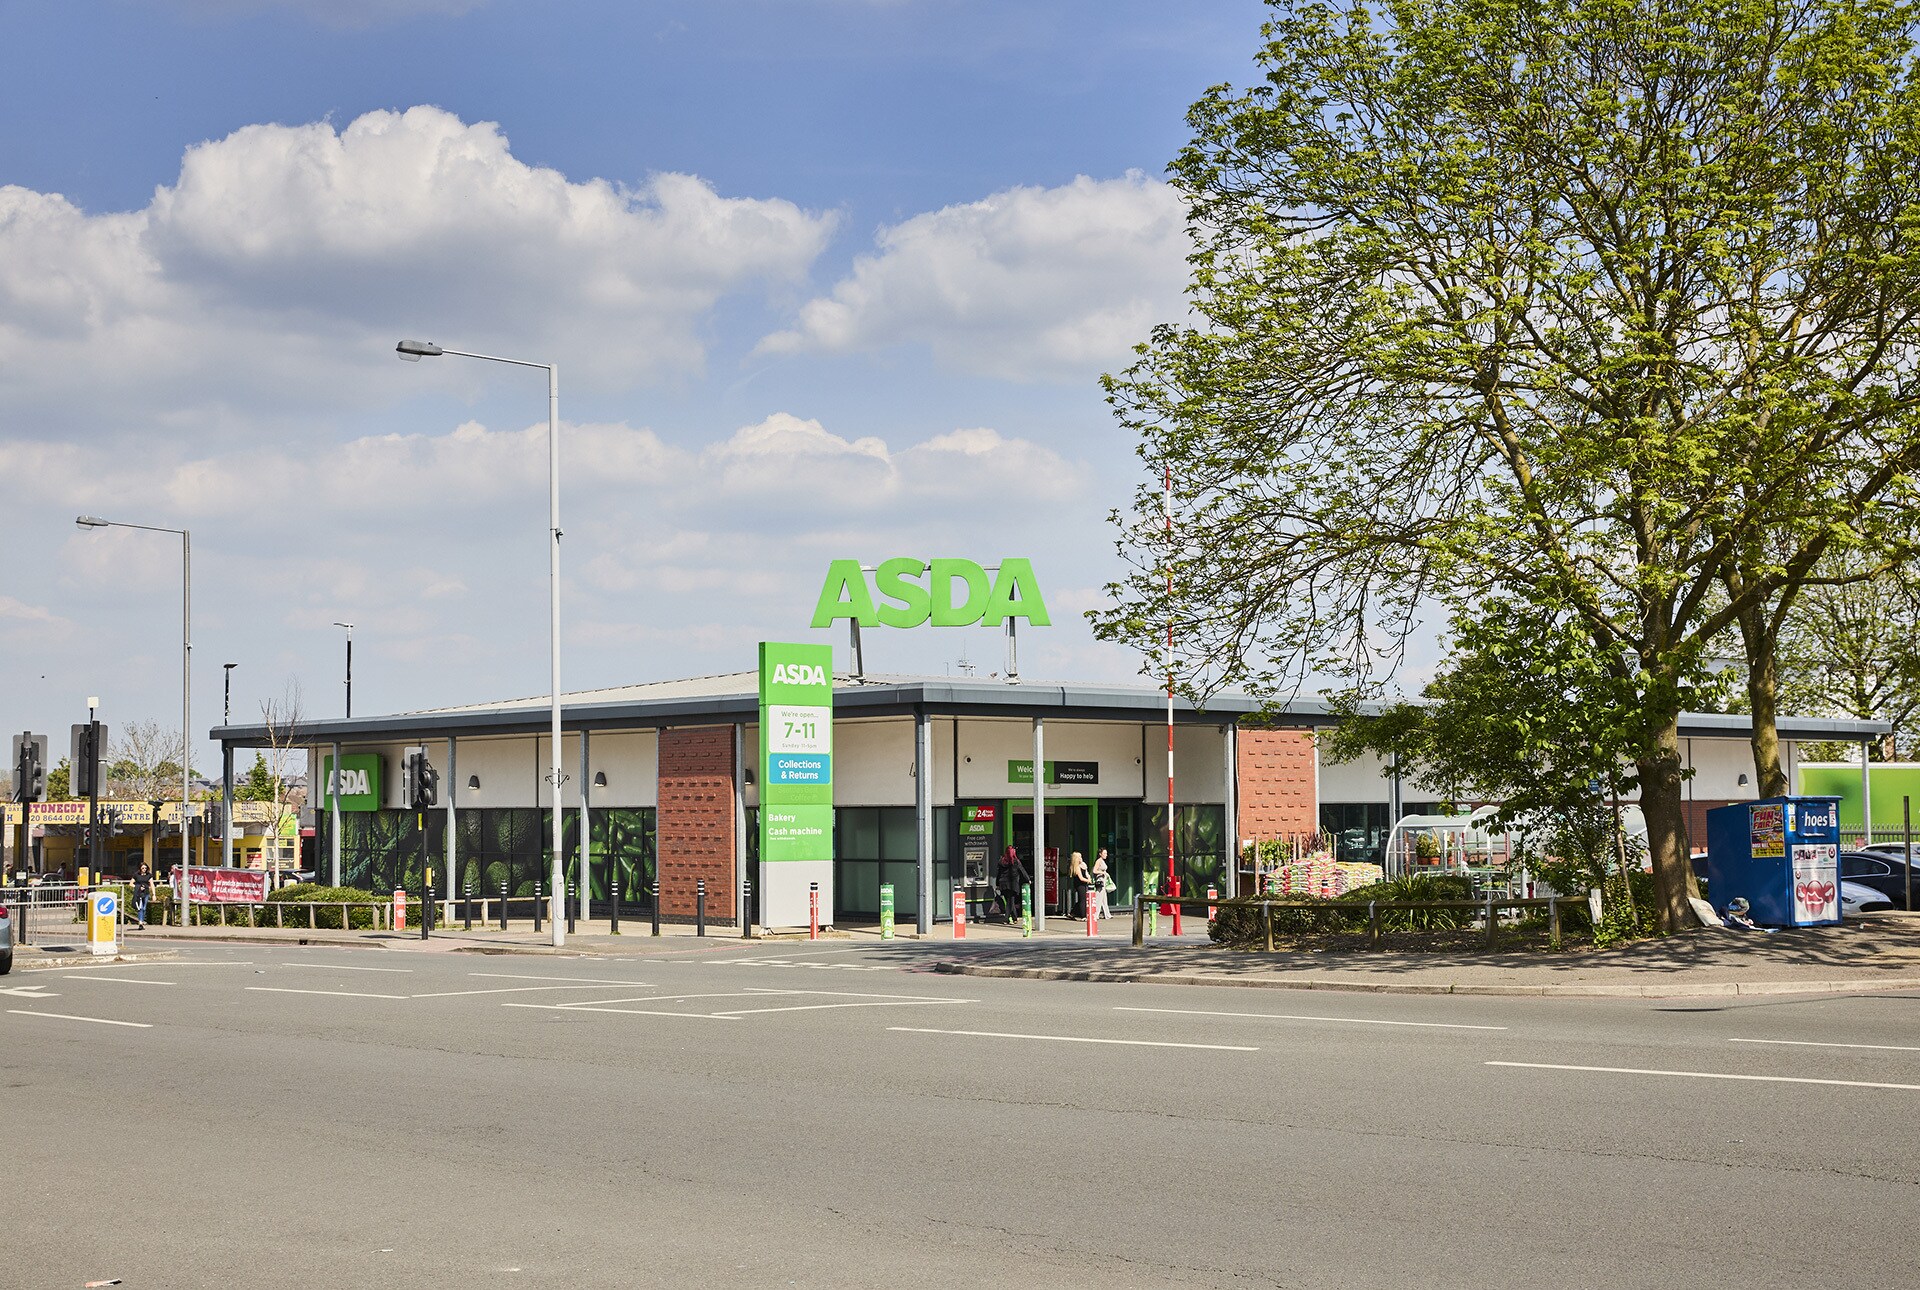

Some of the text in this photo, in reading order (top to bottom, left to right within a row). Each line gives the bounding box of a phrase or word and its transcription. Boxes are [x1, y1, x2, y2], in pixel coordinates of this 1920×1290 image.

[810, 557, 1052, 629] ASDA
[772, 664, 827, 686] ASDA
[784, 722, 815, 739] 7-11
[778, 760, 822, 769] Collections
[1016, 765, 1046, 773] Welc
[780, 771, 819, 780] & Returns
[768, 813, 796, 822] Bakery
[977, 809, 986, 817] 24
[1753, 810, 1774, 821] FUN
[768, 827, 822, 835] Cash machine
[969, 824, 985, 832] ASDA
